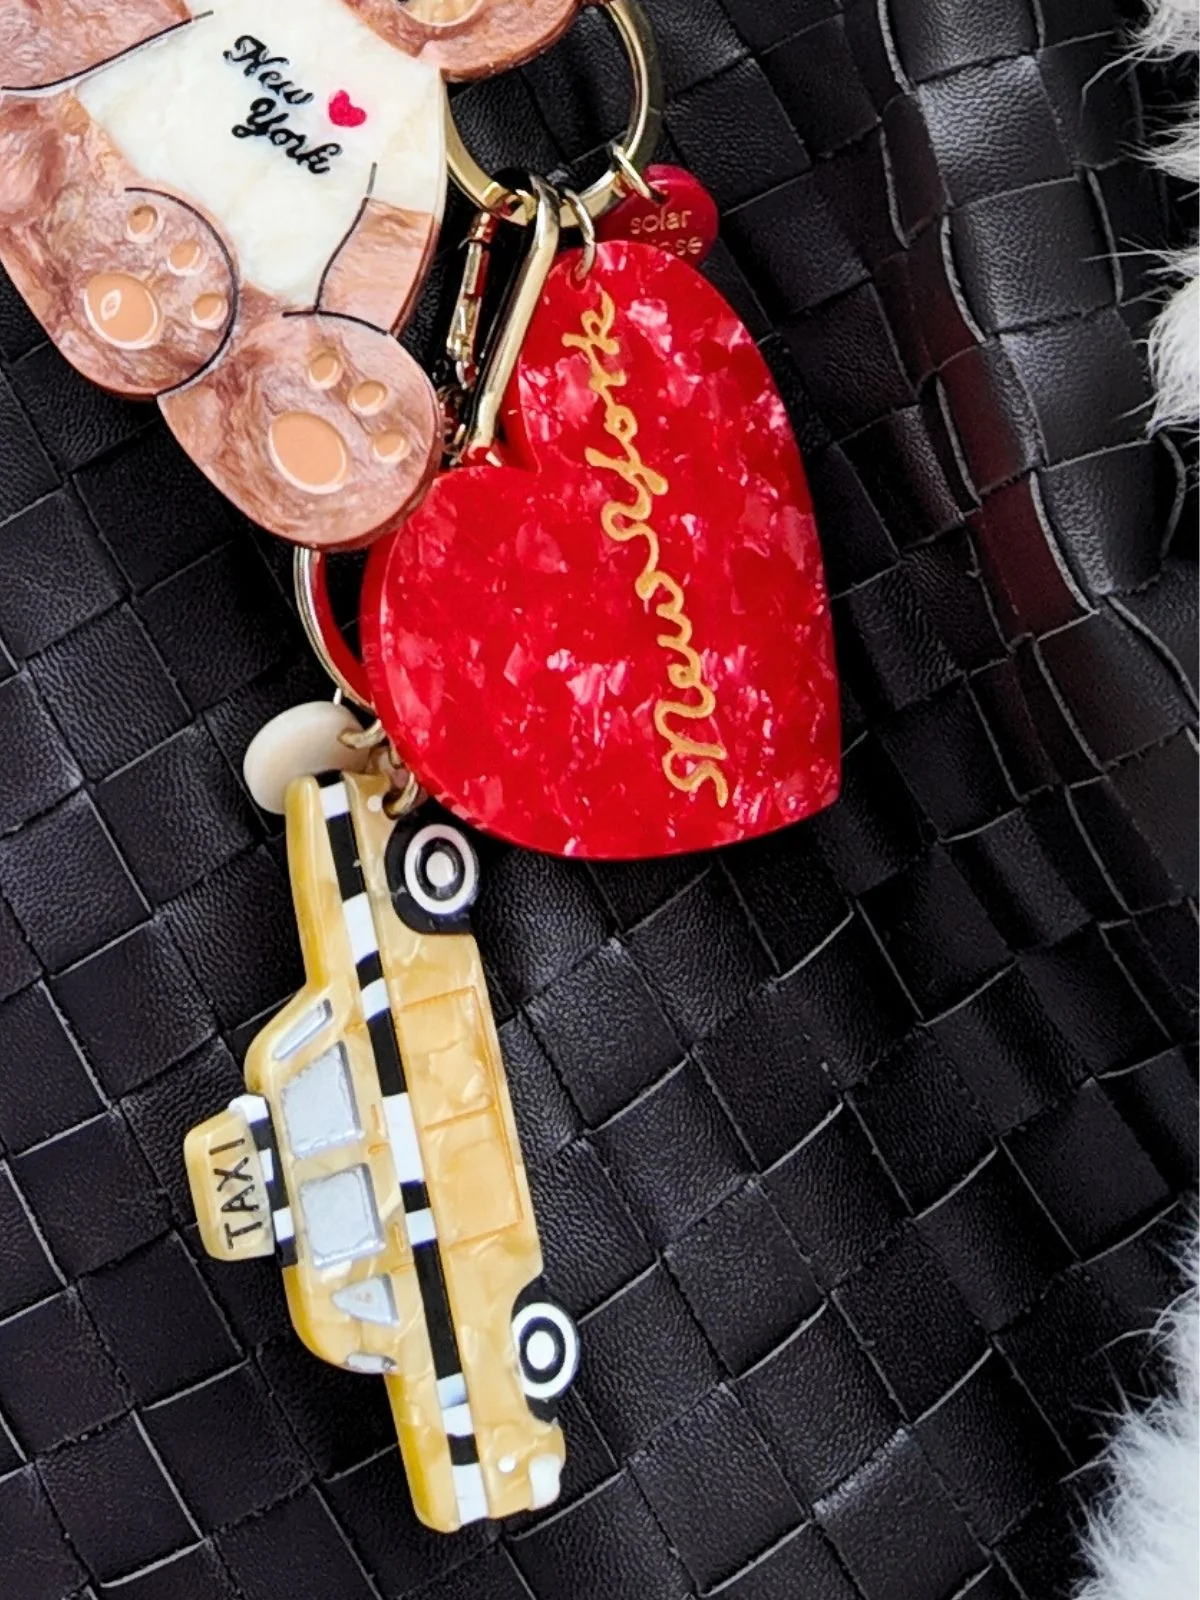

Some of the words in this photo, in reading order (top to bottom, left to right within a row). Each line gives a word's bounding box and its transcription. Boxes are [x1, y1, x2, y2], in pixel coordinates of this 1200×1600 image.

[222, 34, 314, 105] New
[231, 97, 344, 175] York
[629, 205, 694, 236] solar
[561, 288, 670, 575] York
[634, 572, 729, 808] New
[208, 1137, 264, 1250] TAXI
